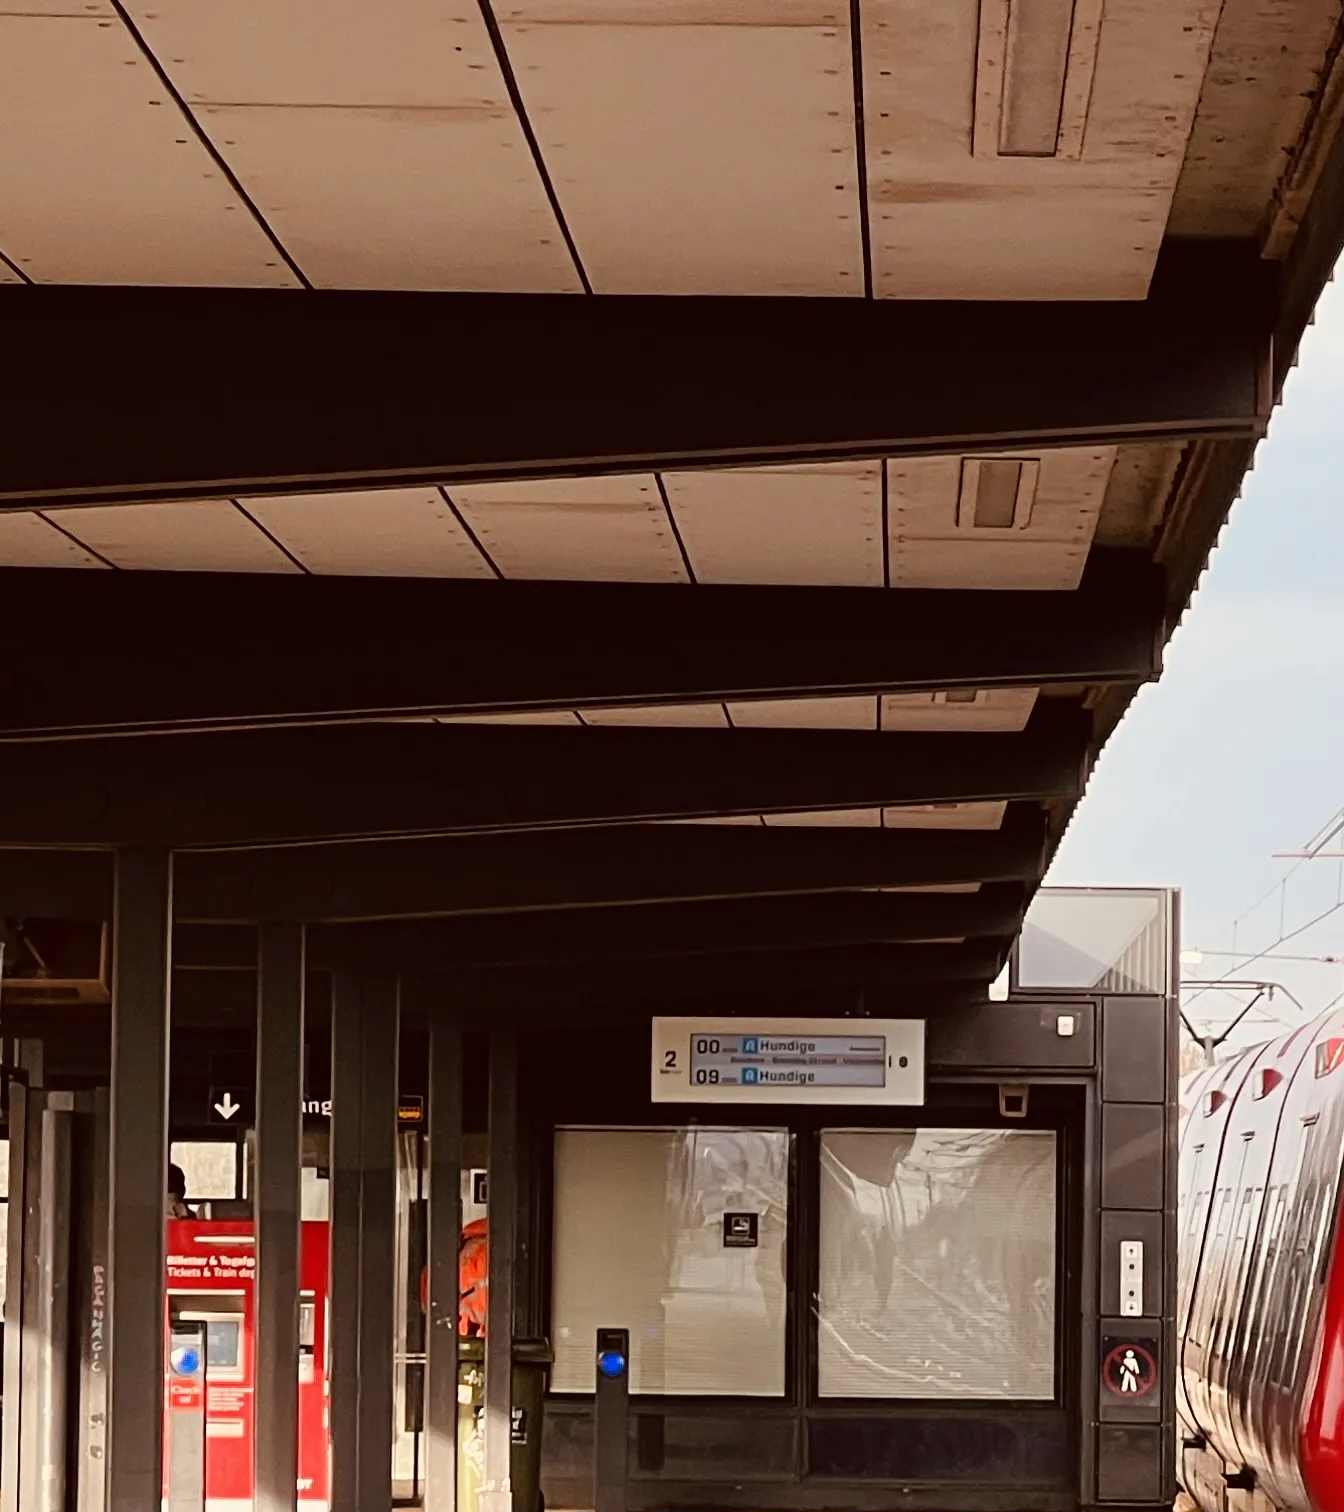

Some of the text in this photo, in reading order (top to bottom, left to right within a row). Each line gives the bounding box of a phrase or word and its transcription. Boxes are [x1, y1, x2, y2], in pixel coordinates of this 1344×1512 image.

[696, 1039, 721, 1054] 00
[760, 1039, 816, 1054] Hundige
[665, 1051, 677, 1067] 2
[696, 1069, 720, 1084] 09
[760, 1071, 815, 1085] Hundige
[209, 1255, 218, 1265] &
[167, 1267, 202, 1277] Tickets
[203, 1267, 211, 1277] &
[213, 1267, 237, 1277] Train
